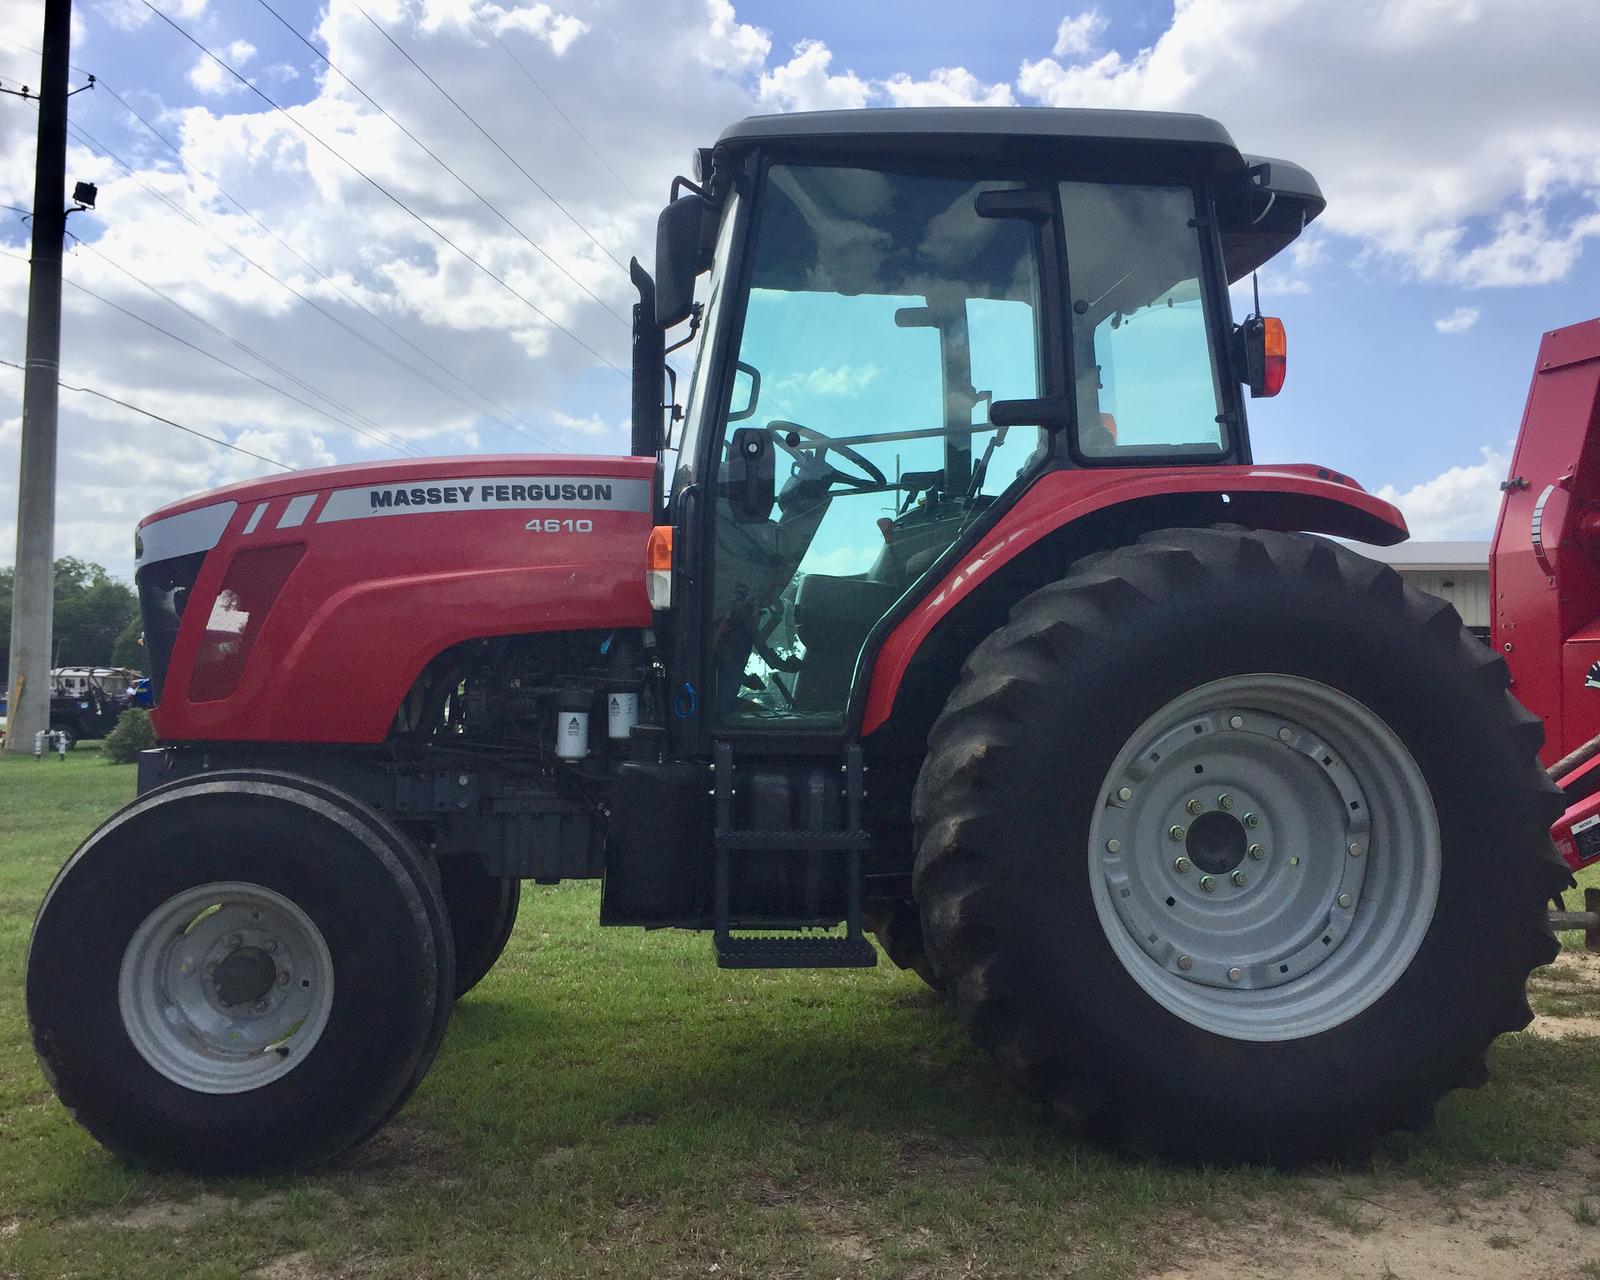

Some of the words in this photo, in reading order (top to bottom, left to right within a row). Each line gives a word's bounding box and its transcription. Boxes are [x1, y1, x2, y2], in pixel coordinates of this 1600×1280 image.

[371, 486, 474, 508] MASSEY
[481, 484, 612, 502] FERGUSON
[525, 519, 593, 533] 4610
